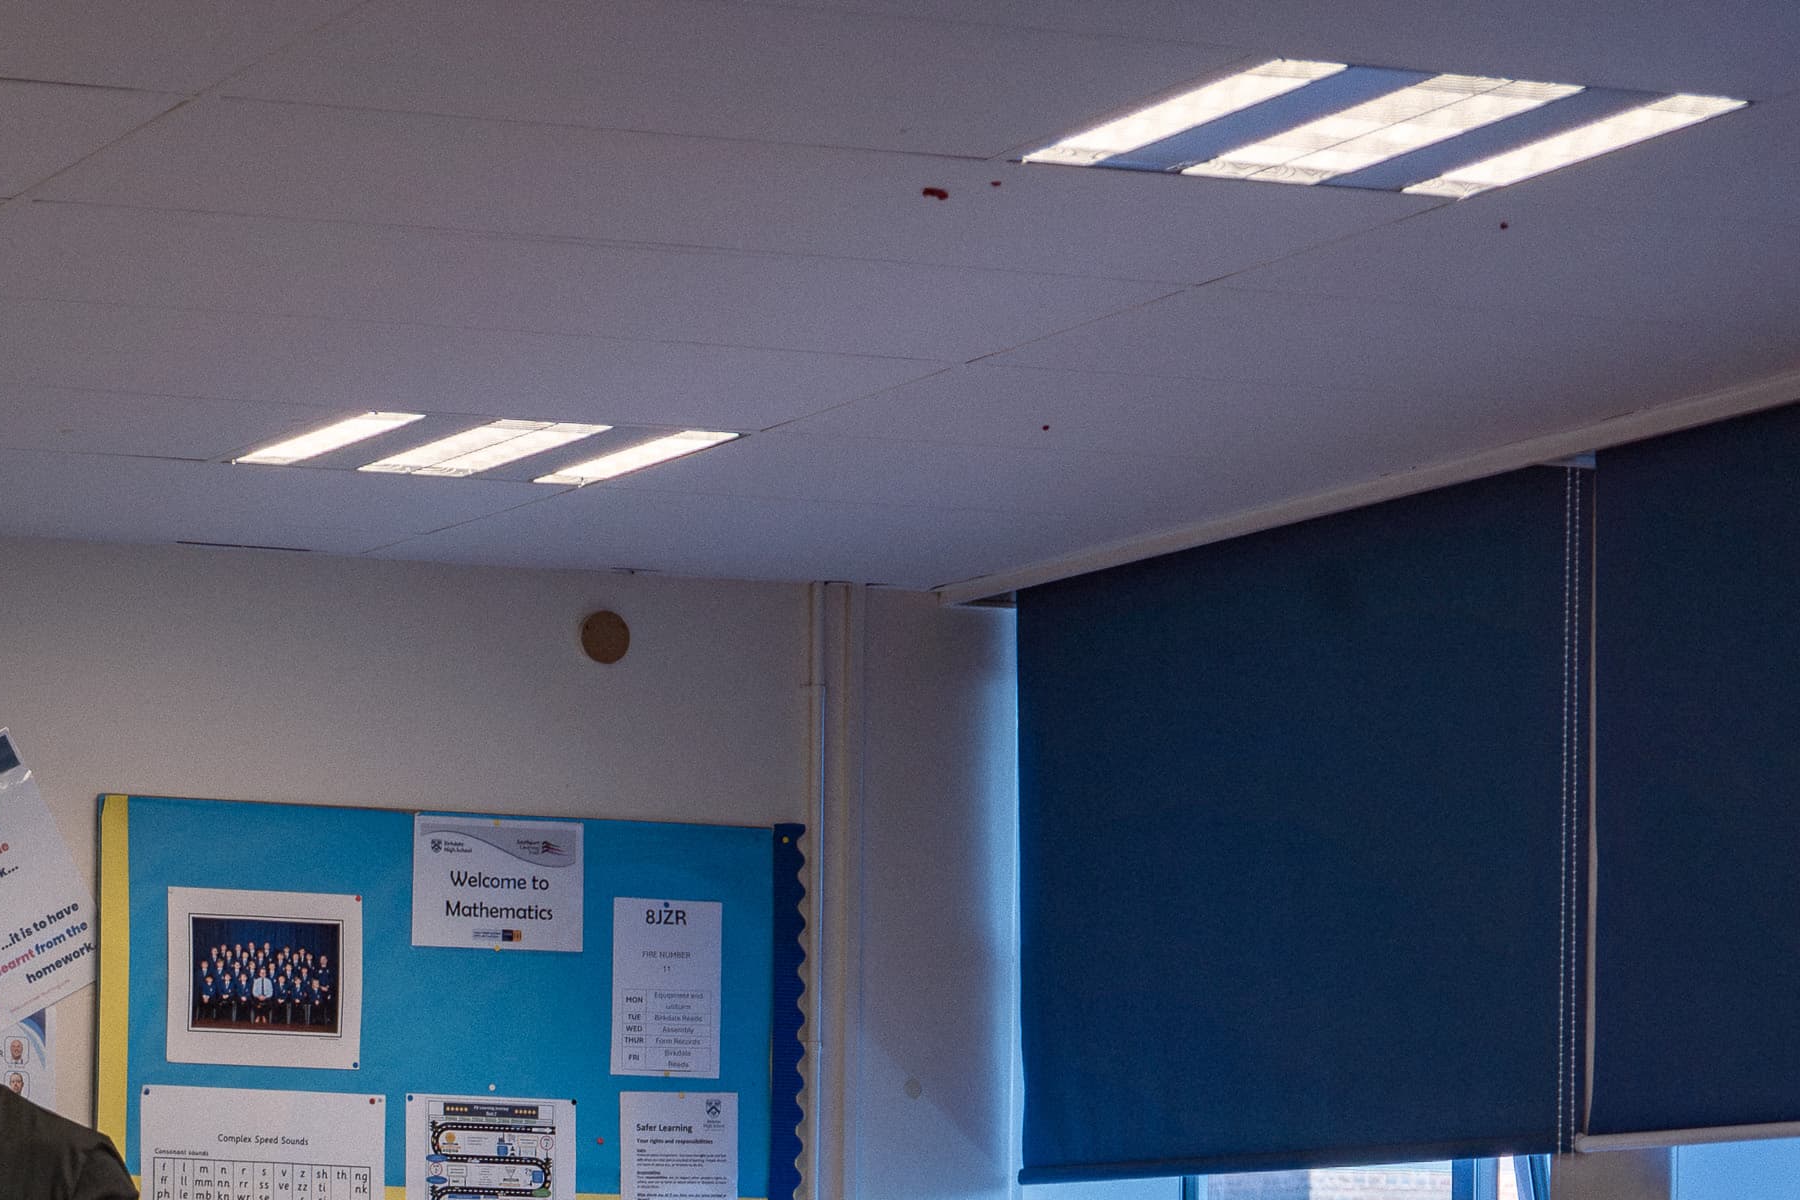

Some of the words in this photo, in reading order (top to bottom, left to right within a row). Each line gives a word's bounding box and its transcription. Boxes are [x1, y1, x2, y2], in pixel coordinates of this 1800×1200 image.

[451, 871, 526, 889] Welcome
[532, 876, 549, 890] to
[446, 901, 552, 920] Mathematics
[646, 910, 686, 925] 8JZR
[20, 928, 33, 939] is
[33, 921, 47, 931] to
[47, 903, 79, 924] have
[35, 934, 66, 955] from
[66, 922, 87, 937] the
[659, 951, 691, 959] NUMBER
[637, 1124, 656, 1132] Safer
[659, 1124, 692, 1133] Learning
[218, 1134, 251, 1144] Complex
[255, 1136, 278, 1145] Speed
[282, 1136, 308, 1145] Sounds
[317, 1169, 327, 1179] sh
[337, 1170, 346, 1179] th
[355, 1173, 367, 1183] ng
[161, 1176, 168, 1184] ff
[355, 1184, 367, 1193] nk
[157, 1189, 169, 1200] ph
[180, 1189, 188, 1199] le
[196, 1191, 211, 1200] mb
[218, 1192, 229, 1200] kn
